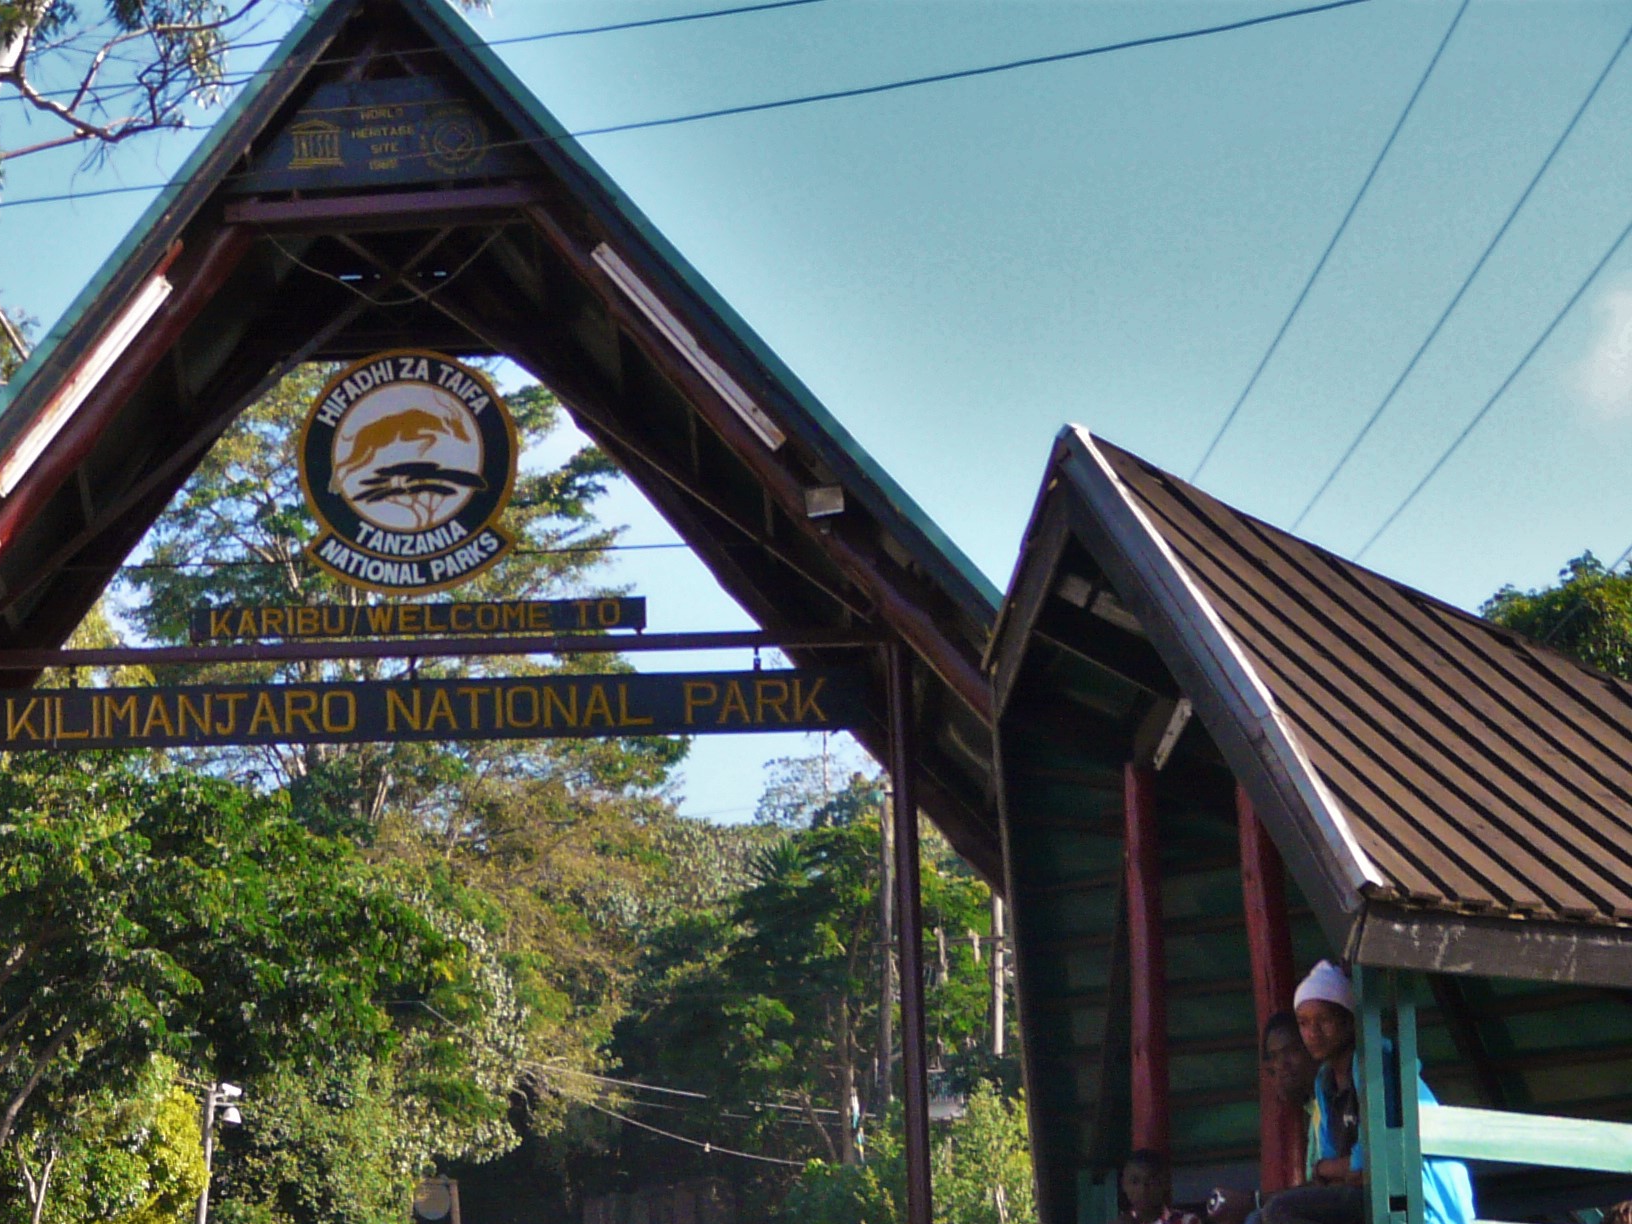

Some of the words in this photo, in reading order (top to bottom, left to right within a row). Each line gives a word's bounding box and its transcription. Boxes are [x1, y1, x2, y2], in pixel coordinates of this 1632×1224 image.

[350, 125, 415, 139] HERITAGE
[370, 143, 399, 154] SITE
[316, 359, 394, 427] HIFADHI
[399, 357, 430, 381] ZA
[438, 363, 491, 415] TAIFA
[355, 519, 468, 556] TANZANIA
[320, 538, 426, 585] NATIONAL
[430, 531, 499, 582] PARKS
[574, 599, 621, 627] TO
[5, 690, 356, 742] KILIMANJARO
[386, 683, 654, 732] NATIONAL
[682, 677, 828, 725] PARK
